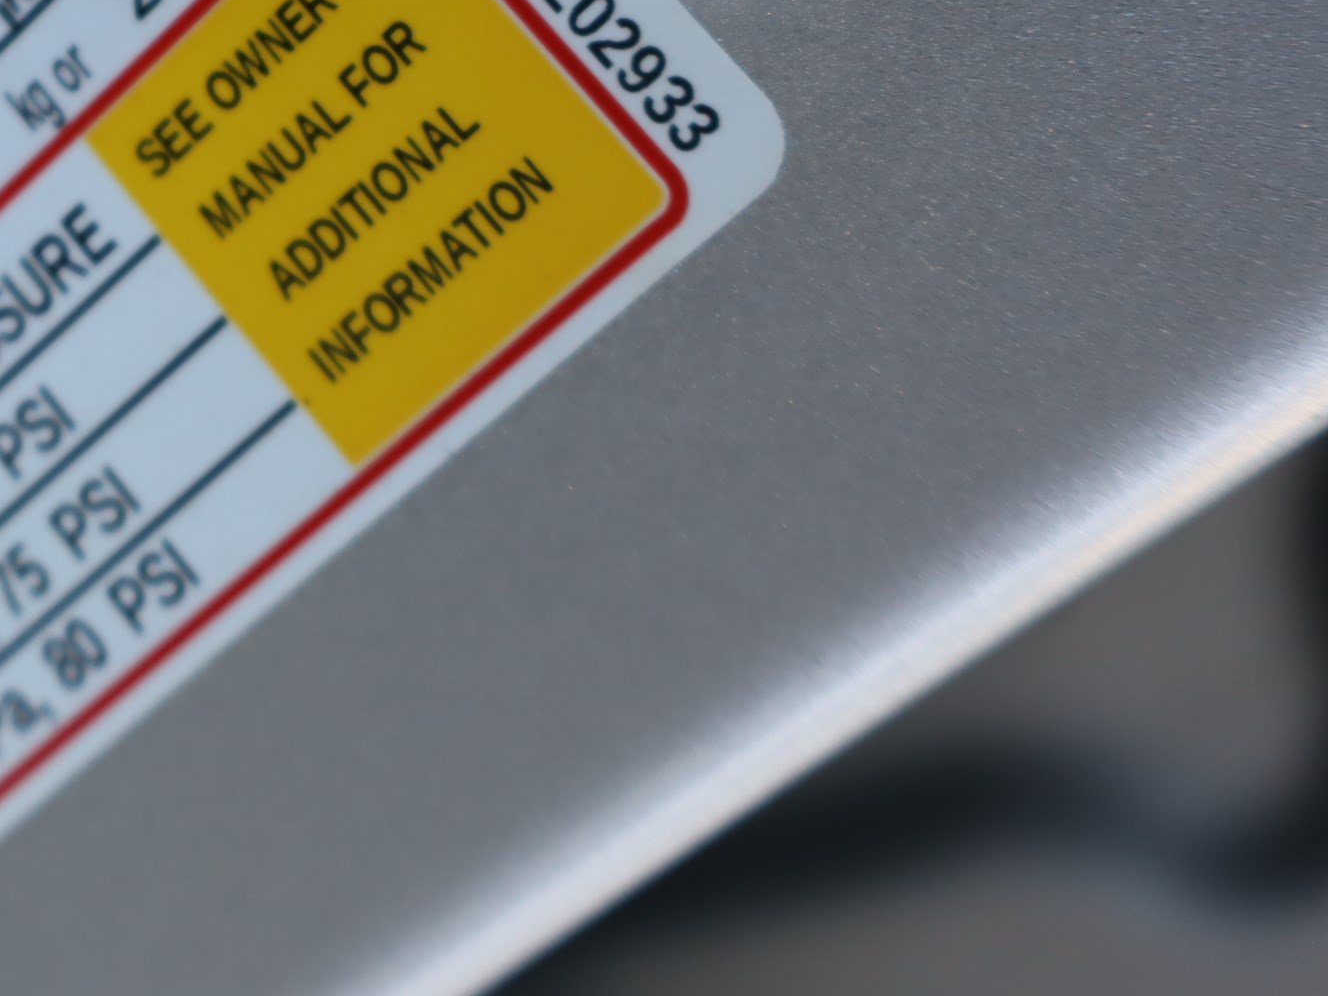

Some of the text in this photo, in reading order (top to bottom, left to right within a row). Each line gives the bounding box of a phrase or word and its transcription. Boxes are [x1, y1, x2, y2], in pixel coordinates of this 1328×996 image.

[5, 80, 71, 135] kg
[52, 45, 90, 92] or
[135, 98, 212, 176] SEE
[199, 21, 425, 237] MANUAL FOR
[269, 107, 480, 299] ADDITIONAL
[309, 156, 553, 381] INFORMATION
[48, 467, 140, 559] PSI
[42, 618, 107, 688] 80
[106, 539, 199, 633] PSI
